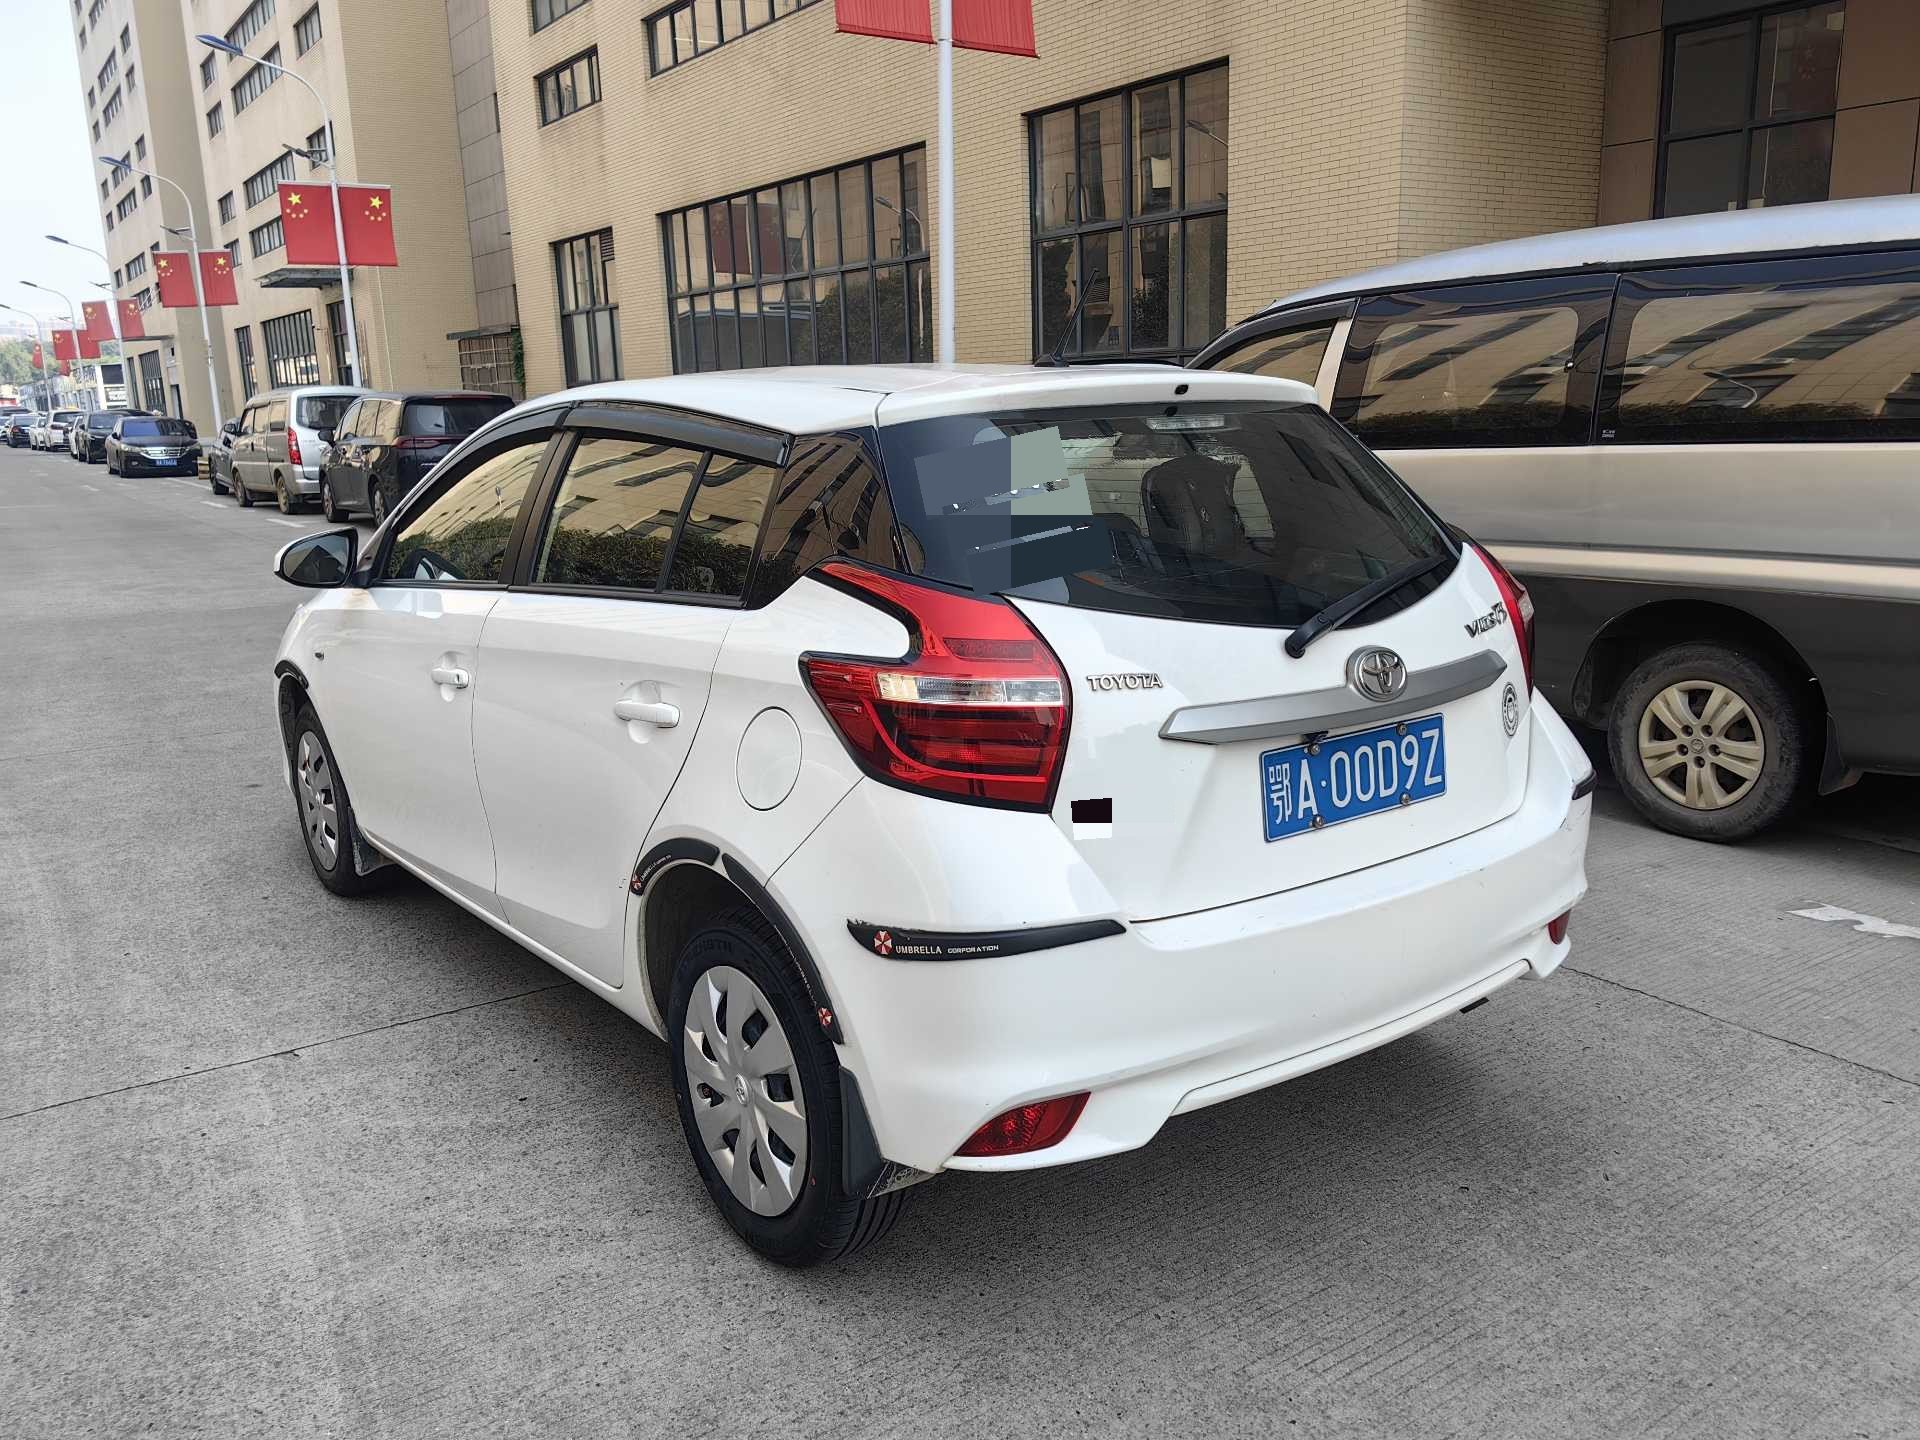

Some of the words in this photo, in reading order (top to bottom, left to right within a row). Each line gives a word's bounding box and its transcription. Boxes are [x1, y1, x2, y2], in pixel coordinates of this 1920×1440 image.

[1086, 673, 1163, 691] TOYOTA
[895, 945, 942, 954] UMBRELLA
[947, 944, 999, 954] CORPORATION
